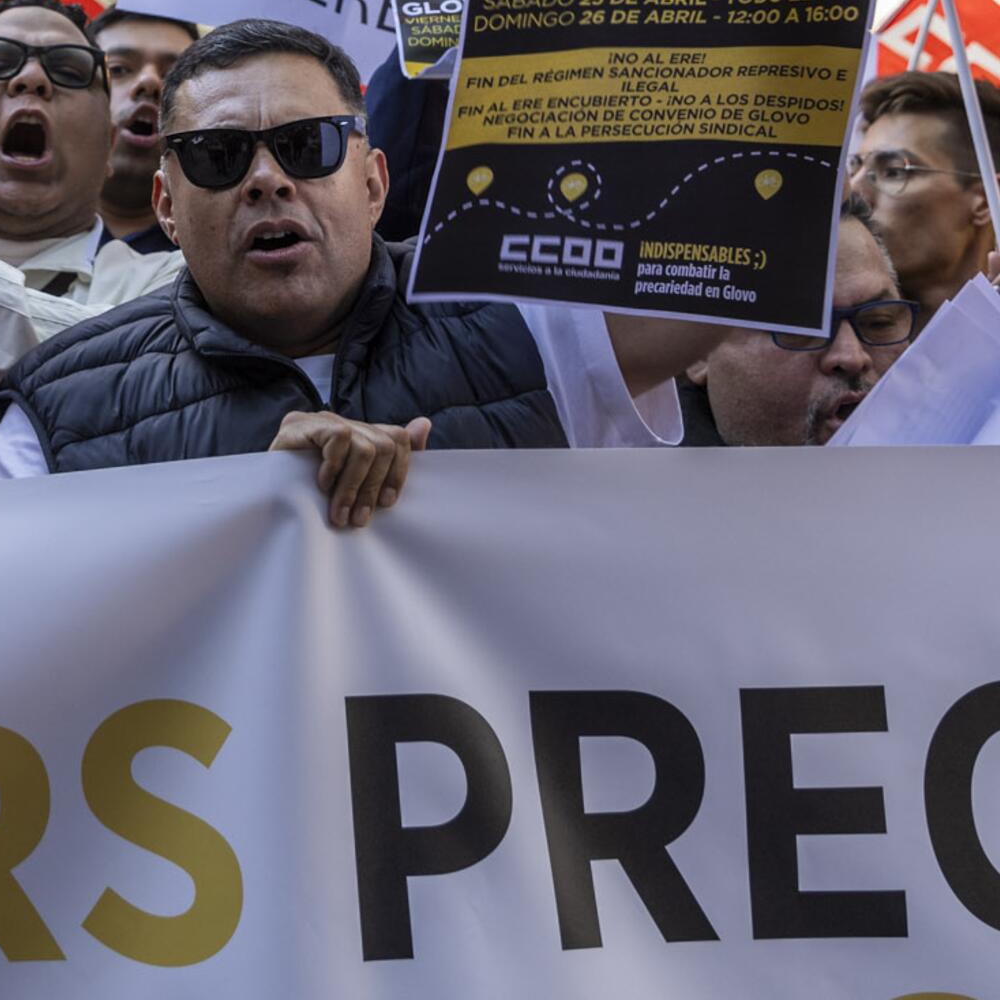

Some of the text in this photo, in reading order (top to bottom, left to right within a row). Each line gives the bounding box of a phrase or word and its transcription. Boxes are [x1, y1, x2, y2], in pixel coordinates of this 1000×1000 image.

[474, 11, 575, 32] DOMINGO
[579, 10, 605, 25] 26
[610, 10, 641, 25] DE
[644, 9, 707, 24] ABRIL
[727, 9, 780, 25] 12:00
[785, 9, 800, 23] A
[805, 6, 859, 22] 16:00
[608, 52, 706, 65] ¡NO AL ERE!
[466, 65, 848, 89] FIN DEL RÉGIMEN SANCIONADOR REPRESIVO E
[621, 81, 679, 93] ILEGAL
[457, 94, 845, 118] FIN AL ERE ENCUBIERTO ¡NO A LOS DESPIDOS!
[483, 107, 810, 126] NEGOCIACIÓN DE CONVENIO DE GLOVO
[507, 121, 778, 139] FIN A LA PERSECUCIÓN SINDICAL
[499, 234, 624, 269] CCOO
[498, 262, 543, 275] servicios
[636, 262, 731, 281] para combatir la
[634, 280, 758, 303] precariedad en Glovo
